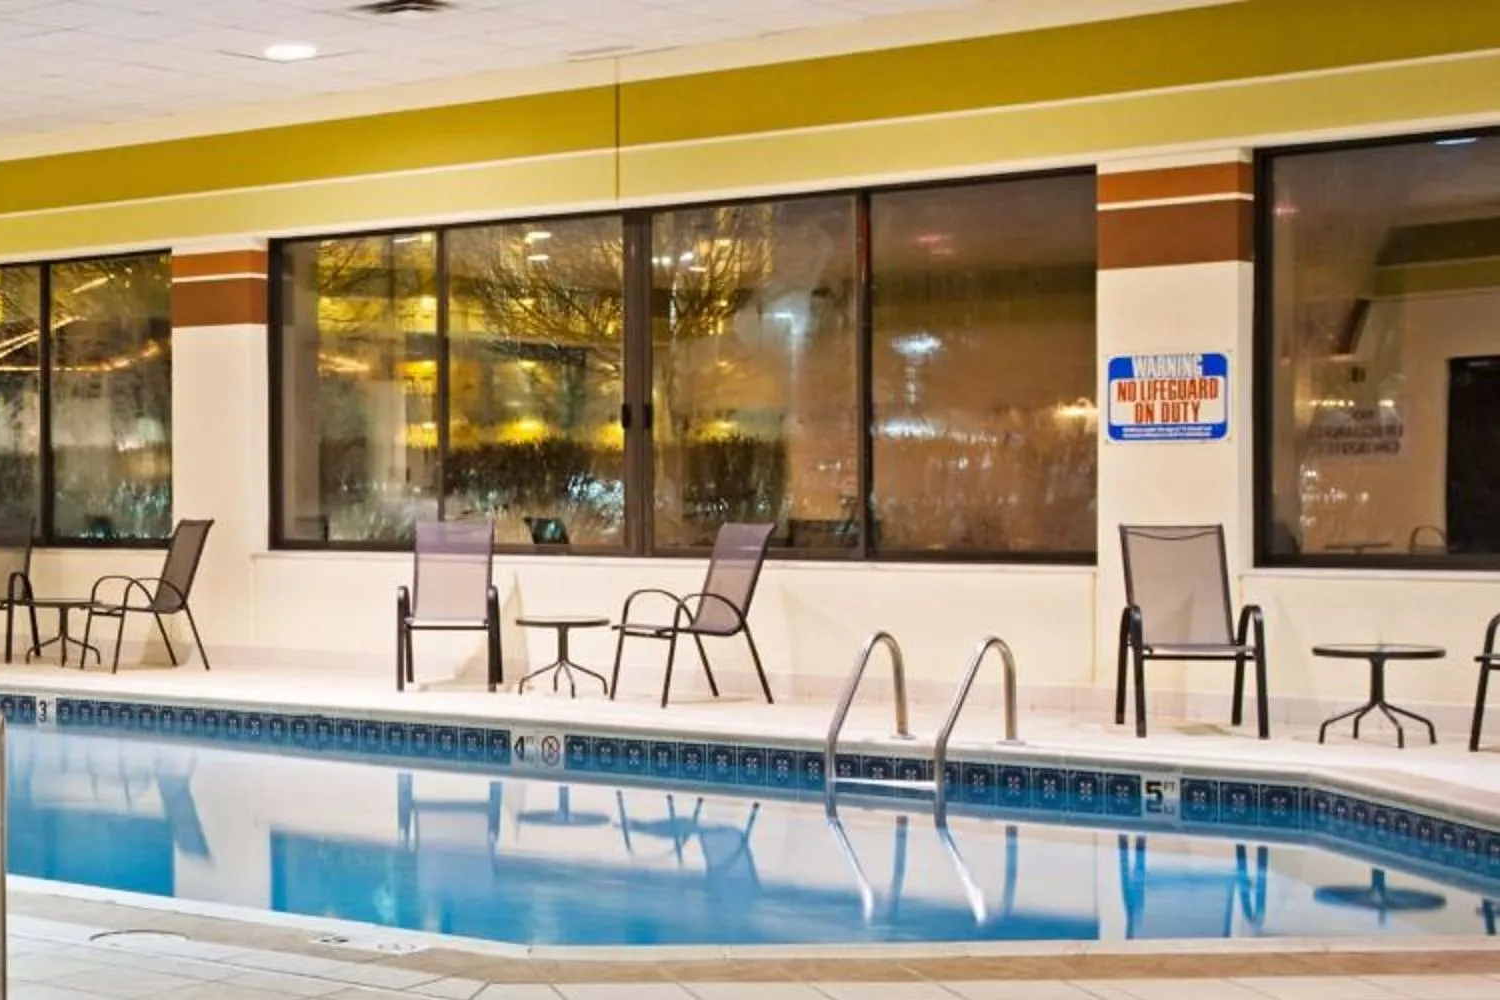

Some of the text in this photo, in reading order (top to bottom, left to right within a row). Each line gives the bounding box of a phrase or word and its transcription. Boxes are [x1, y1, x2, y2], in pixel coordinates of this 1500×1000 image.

[1132, 354, 1202, 378] WARNING
[1117, 378, 1219, 402] NO LIFEGUARD
[1135, 401, 1200, 424] ON DUTY
